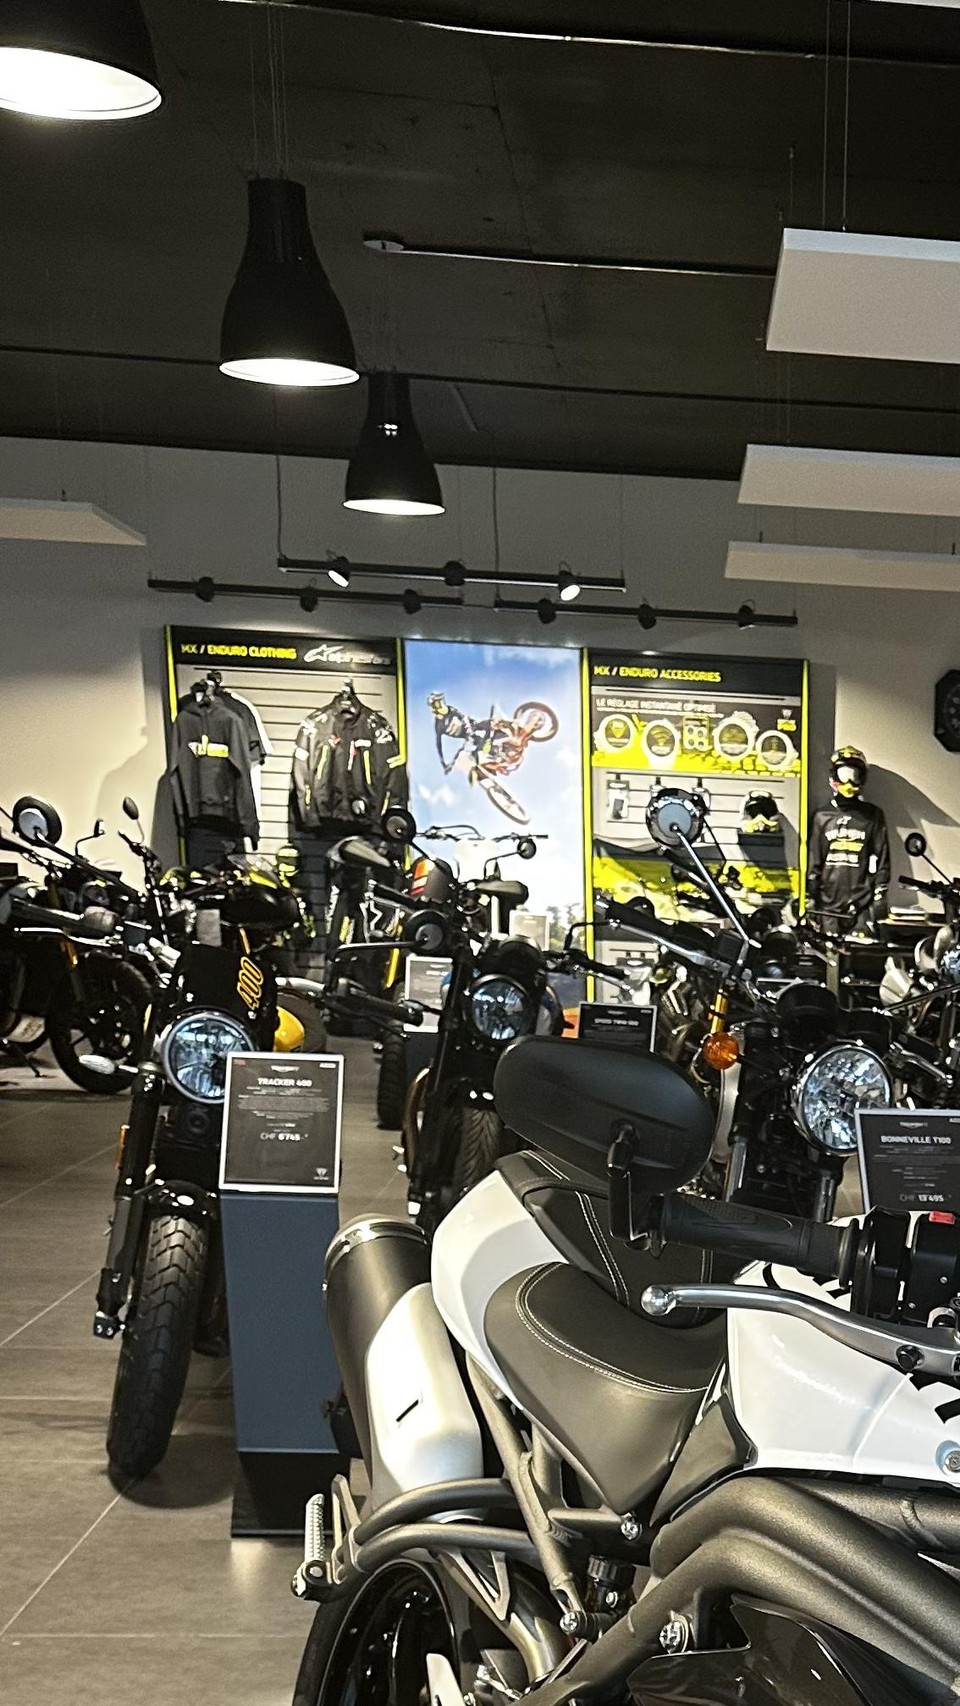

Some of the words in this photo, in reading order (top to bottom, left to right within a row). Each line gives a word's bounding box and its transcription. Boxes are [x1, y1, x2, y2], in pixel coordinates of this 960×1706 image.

[207, 645, 248, 657] ENDURO
[249, 646, 297, 660] CLOTHING
[594, 666, 610, 676] MX
[619, 666, 659, 679] ENDURO
[659, 669, 722, 683] ACCESSORIES
[236, 956, 264, 1011] 400
[257, 1077, 295, 1087] TRACKER
[880, 1135, 931, 1144] BONNEVILLE
[932, 1136, 952, 1145] T100
